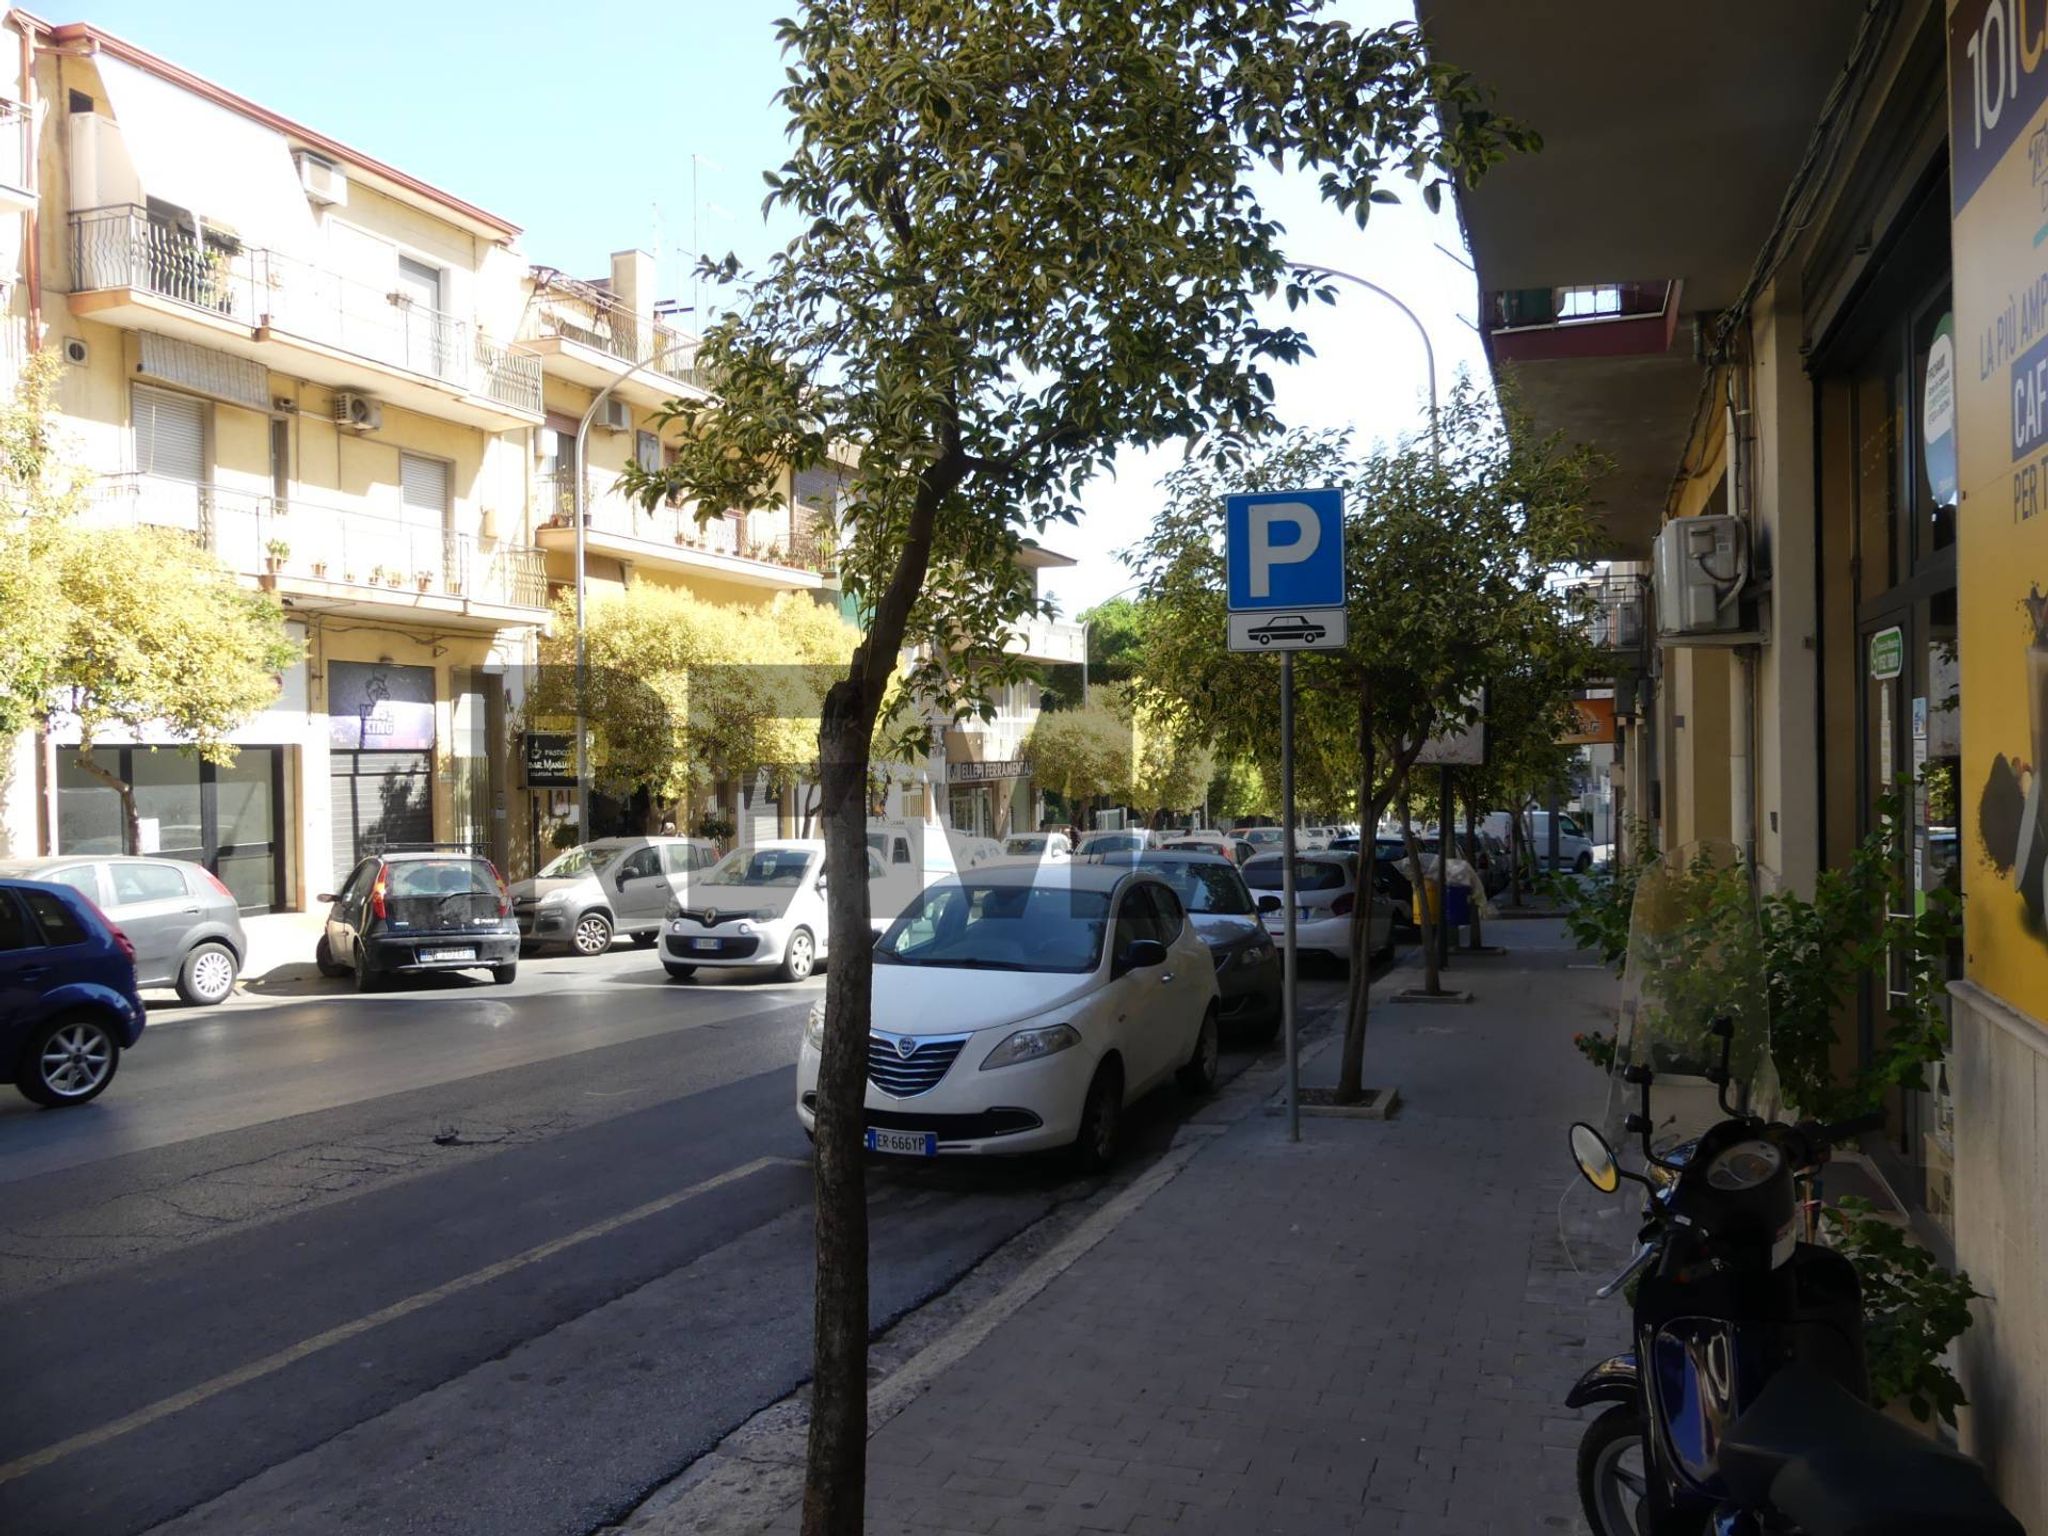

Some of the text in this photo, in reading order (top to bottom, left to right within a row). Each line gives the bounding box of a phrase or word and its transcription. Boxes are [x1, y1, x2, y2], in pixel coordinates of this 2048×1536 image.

[1980, 327, 1994, 381] LA
[1997, 294, 2017, 367] PIÙ
[2014, 464, 2038, 525] PER
[1248, 502, 1321, 598] P
